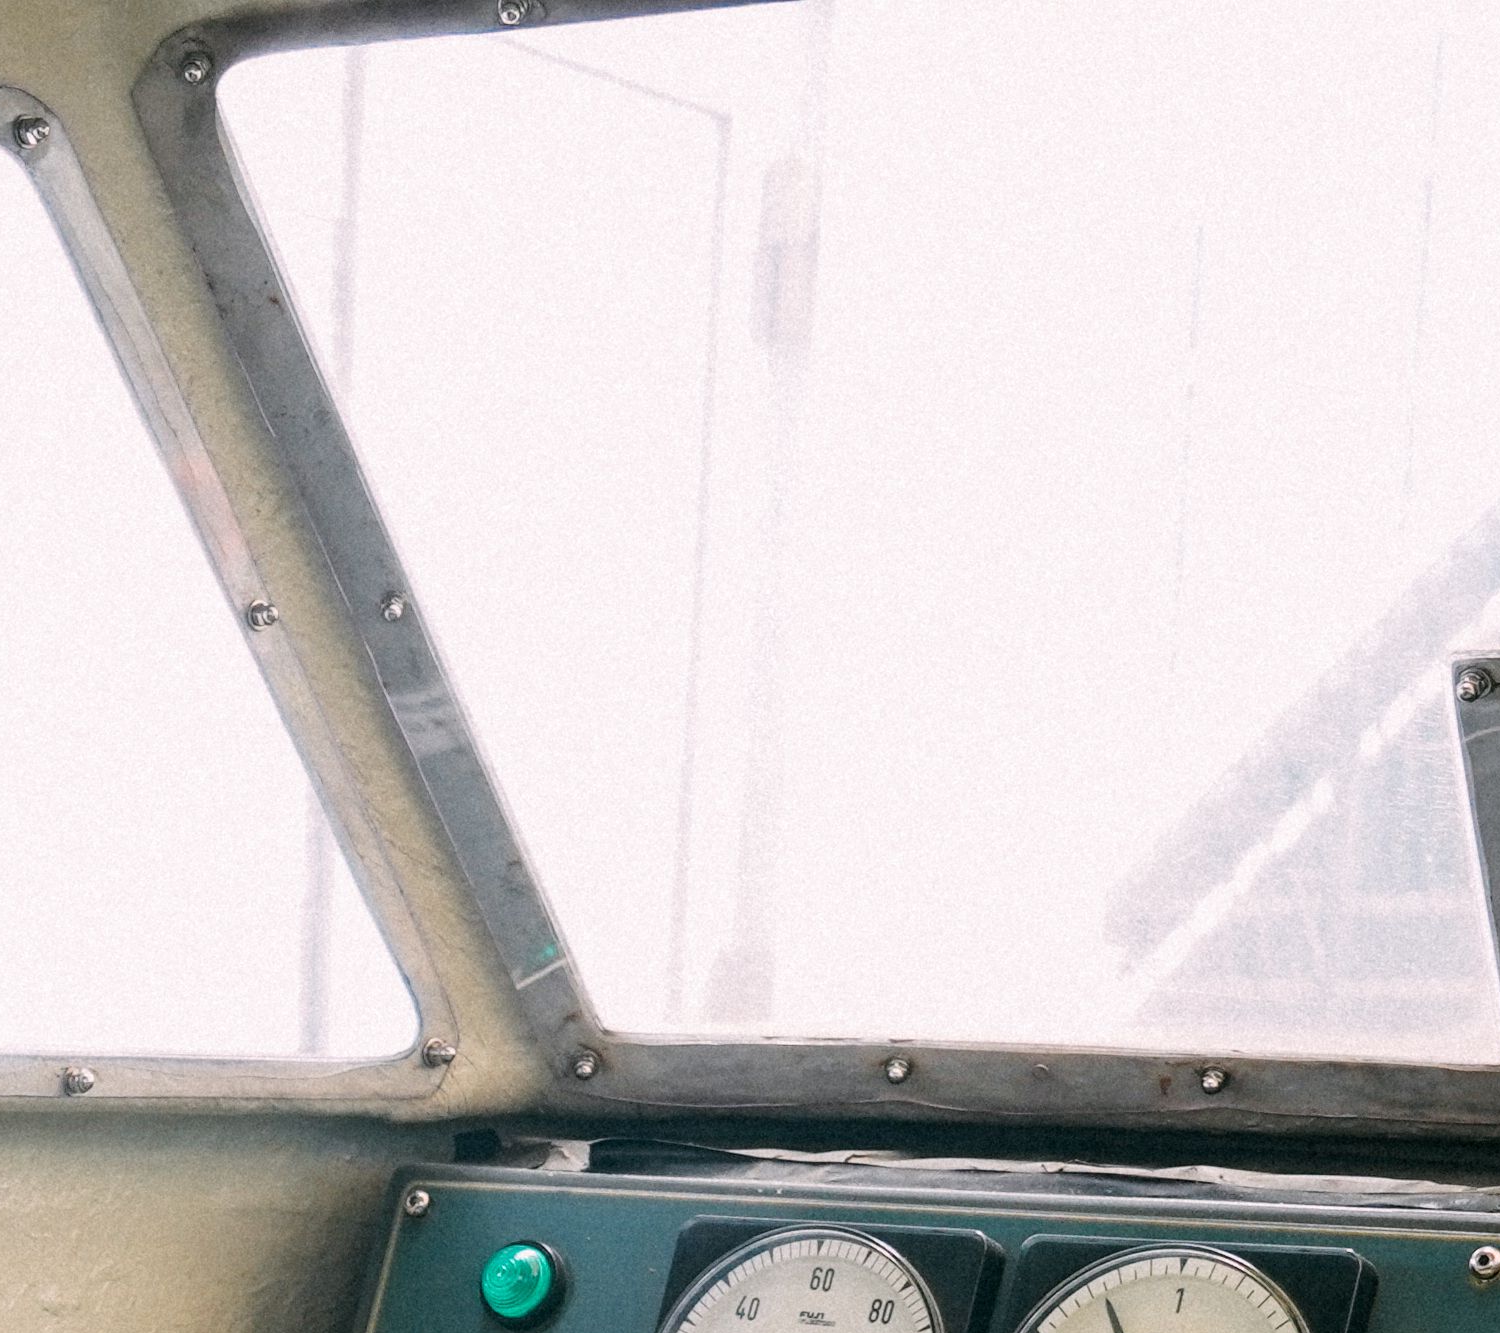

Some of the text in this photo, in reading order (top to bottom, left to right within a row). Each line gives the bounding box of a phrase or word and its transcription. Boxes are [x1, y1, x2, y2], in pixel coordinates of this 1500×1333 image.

[810, 1267, 835, 1292] 60
[735, 1296, 760, 1321] 40
[868, 1299, 895, 1325] 80
[1175, 1288, 1185, 1314] 1
